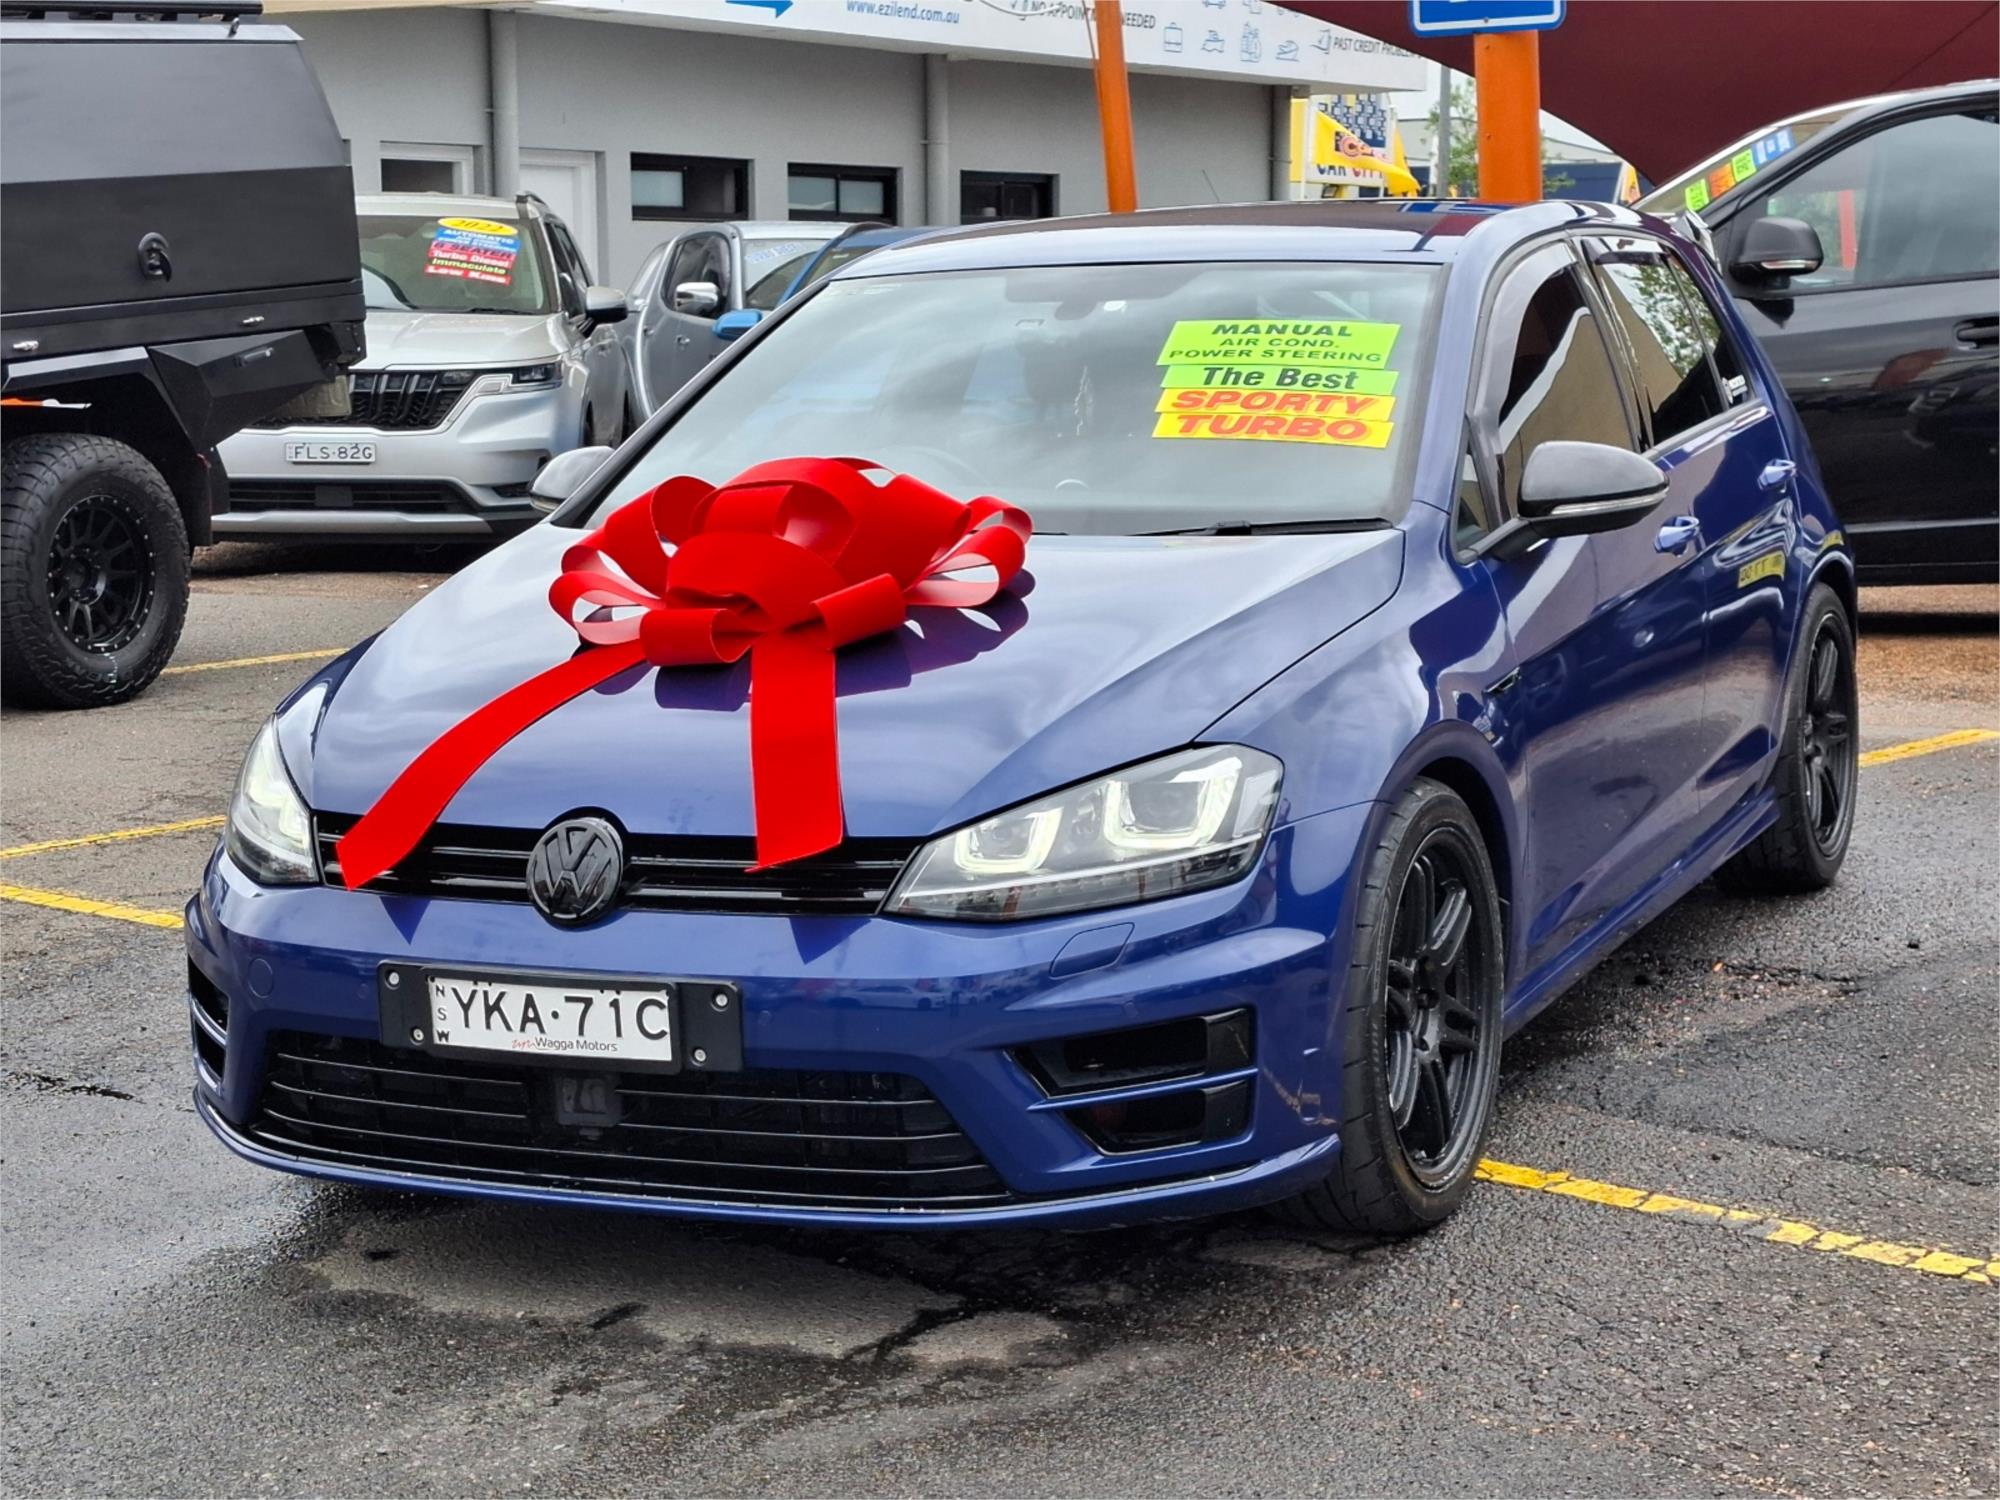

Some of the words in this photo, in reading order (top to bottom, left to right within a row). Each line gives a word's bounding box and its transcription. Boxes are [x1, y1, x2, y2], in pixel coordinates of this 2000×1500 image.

[846, 1, 960, 24] www.ezilend.com.au
[1048, 2, 1097, 22] APPOINT
[1212, 324, 1353, 337] MANUAL
[1220, 338, 1260, 347] AIR
[1268, 338, 1340, 349] COND.
[1169, 349, 1252, 359] POWER
[1261, 350, 1383, 363] STEERING
[1203, 367, 1265, 386] The
[1275, 368, 1359, 389] Best
[1171, 390, 1383, 415] SPORTY
[1176, 414, 1371, 441] TURBO
[534, 1036, 574, 1051] Wagga
[575, 1039, 619, 1052] Motors
